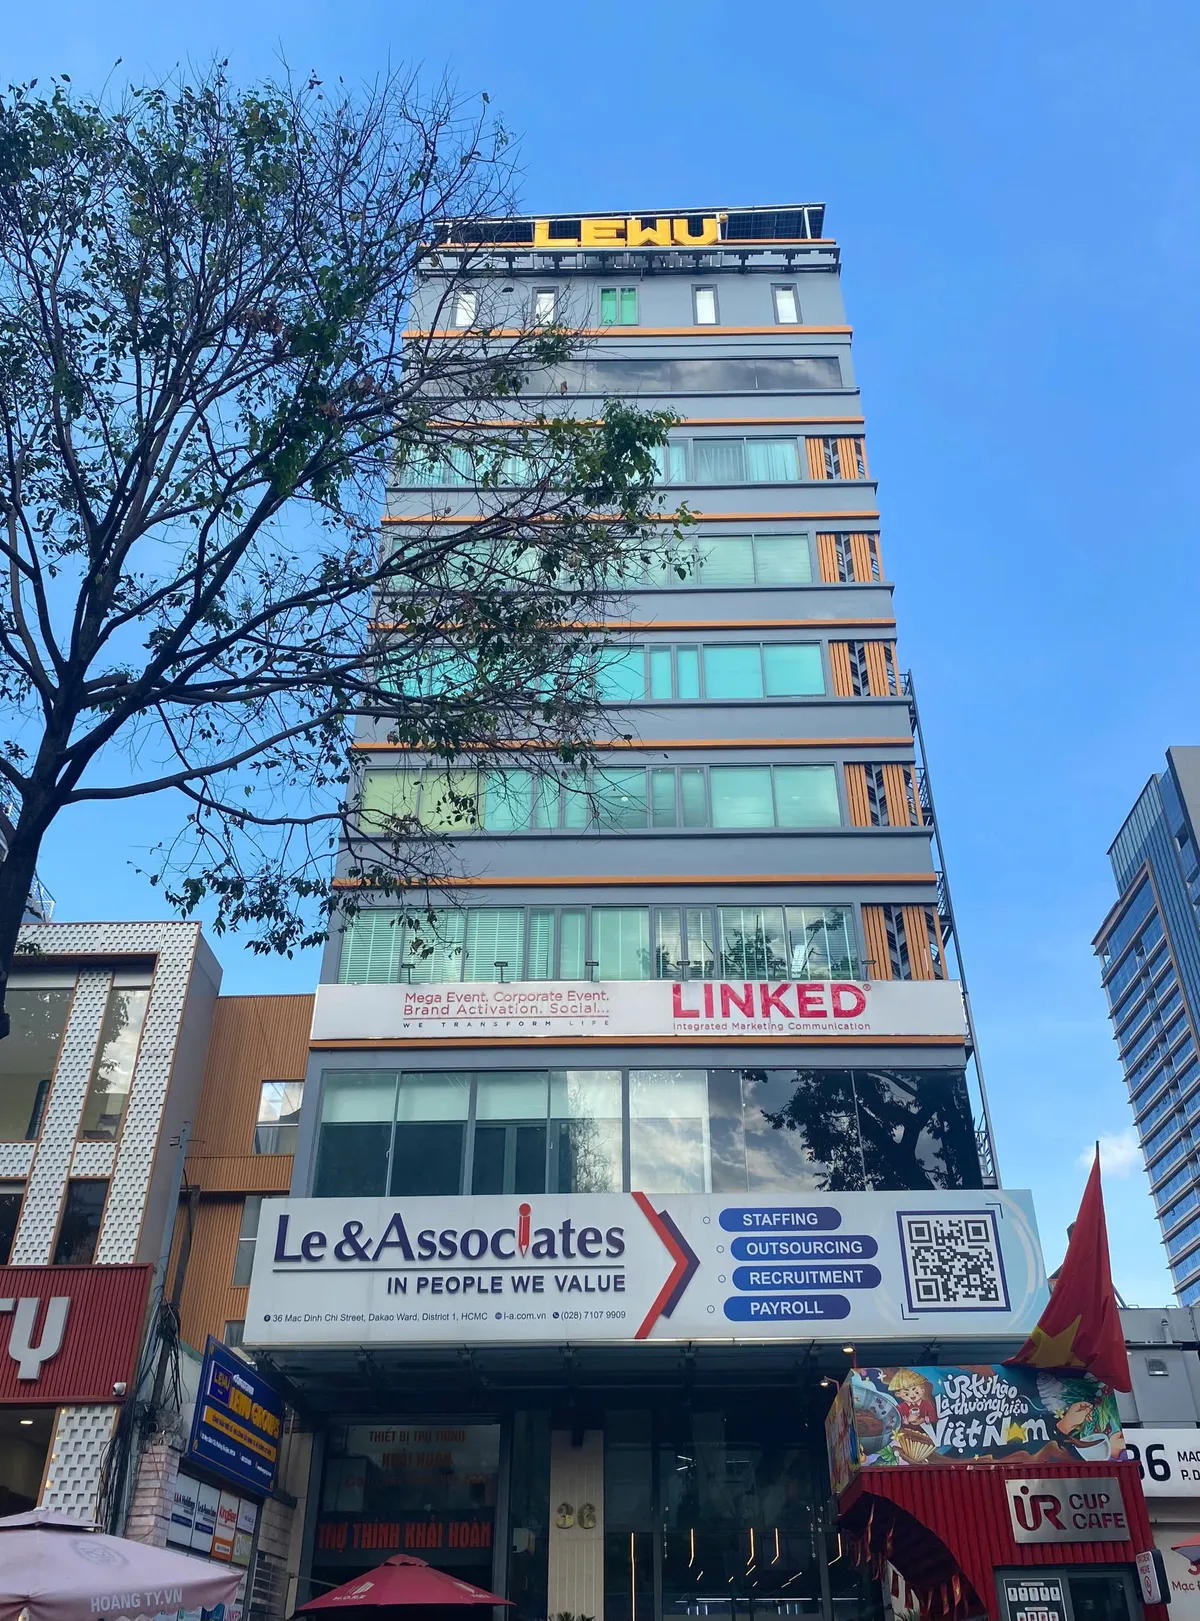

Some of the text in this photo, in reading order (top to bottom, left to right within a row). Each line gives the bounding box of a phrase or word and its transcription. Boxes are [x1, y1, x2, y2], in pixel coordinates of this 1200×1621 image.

[534, 218, 719, 247] LEWU
[404, 990, 609, 1004] Mega Event. Corporate Event.
[403, 1002, 609, 1016] Brand Activation. Social...
[673, 1022, 871, 1031] Integrated Marketing Communication
[743, 1212, 818, 1226] STAFFING
[746, 1240, 863, 1256] OUTSOURCING
[386, 1274, 626, 1294] IN PEOPLE WE VALUE
[749, 1270, 864, 1286] RECRUITMENT
[272, 1314, 283, 1322] 36
[284, 1314, 302, 1322] Mac
[304, 1314, 322, 1322] Dinh
[324, 1313, 338, 1322] Chi
[340, 1312, 366, 1323] Street,
[368, 1312, 394, 1321] Dakao
[396, 1312, 420, 1322] Ward,
[422, 1312, 450, 1321] District
[462, 1312, 488, 1320] HCMC
[560, 1310, 582, 1320] (028)
[584, 1310, 604, 1319] 7107
[606, 1310, 626, 1319] 9909
[750, 1301, 824, 1316] PAYROLL
[1068, 1493, 1110, 1510] CUP
[556, 1502, 596, 1530] 36
[1072, 1512, 1126, 1530] CAFE
[91, 1588, 183, 1612] HOANG TY.VN
